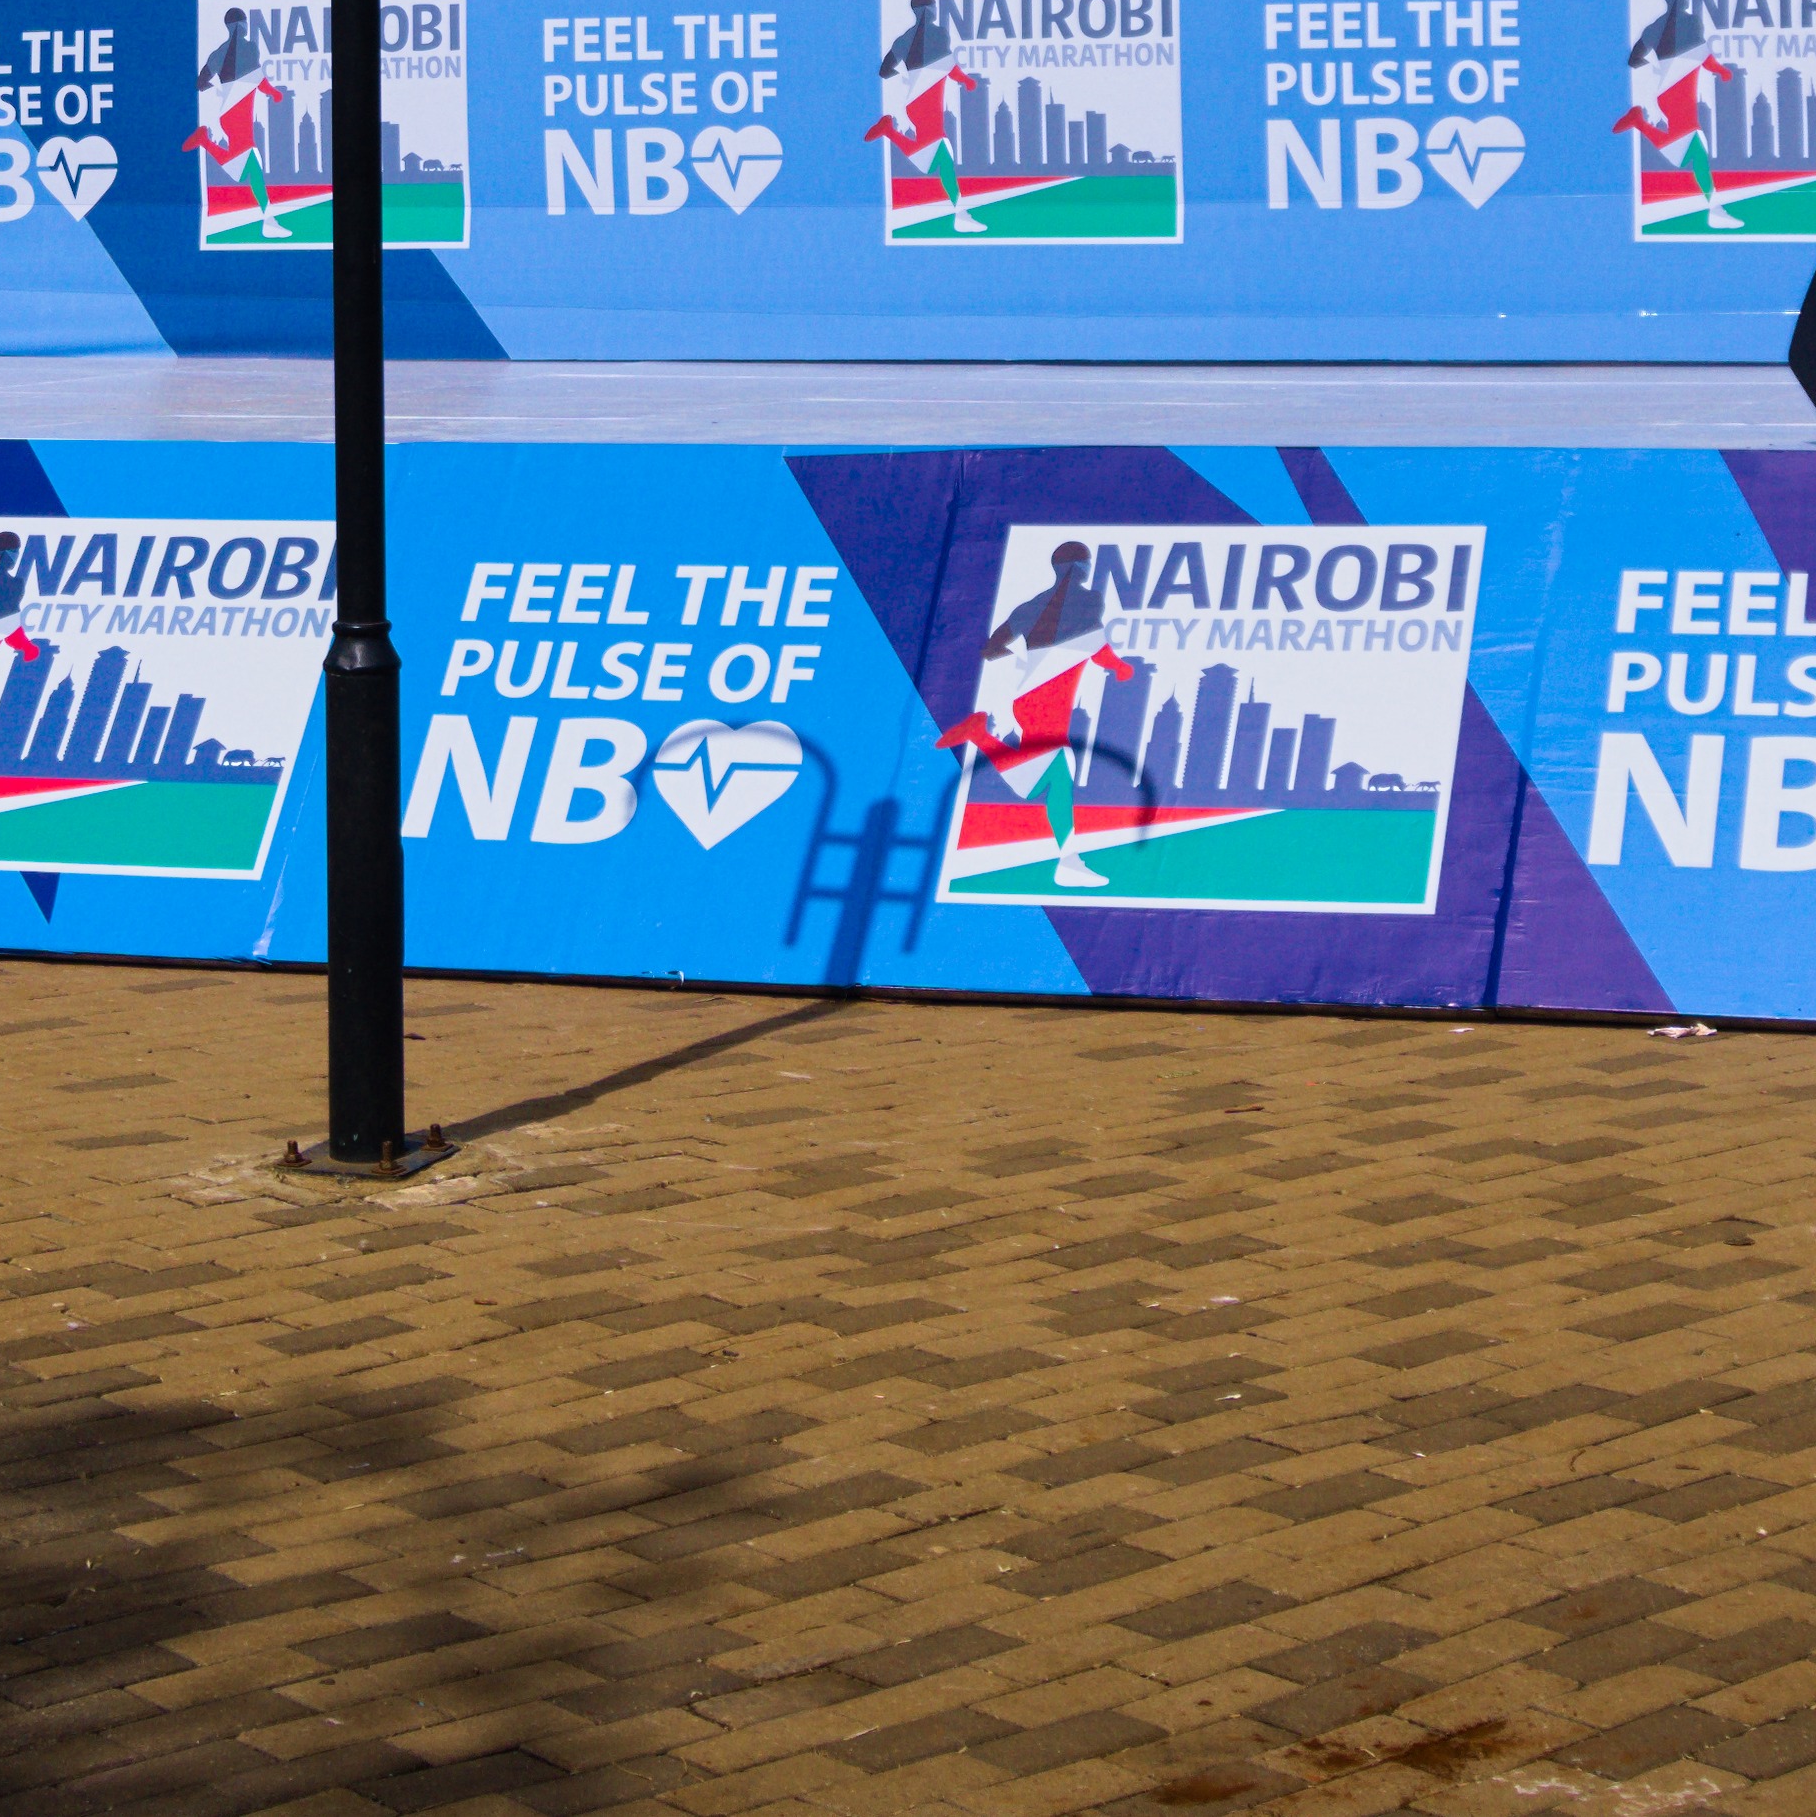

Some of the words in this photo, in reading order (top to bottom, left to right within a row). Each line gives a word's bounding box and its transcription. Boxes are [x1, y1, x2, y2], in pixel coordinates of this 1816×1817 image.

[249, 3, 460, 55] NAIOBI
[543, 17, 663, 62] FEEL
[674, 13, 778, 59] THE
[1264, 2, 1396, 50] FEEL
[1407, 0, 1519, 47] THE
[1708, 34, 1769, 59] CITY
[21, 29, 114, 73] THE
[262, 59, 313, 81] CITY
[953, 45, 1010, 68] CITY
[1018, 42, 1174, 67] MARATHON
[55, 84, 114, 125] OF
[545, 74, 697, 117] PULSE
[711, 71, 777, 114] OF
[1266, 61, 1433, 107] PULSE
[1448, 59, 1519, 104] OF
[14, 532, 337, 601] NAIROBI
[1091, 542, 1471, 612] NAIROBI
[460, 562, 659, 627] FEEL
[677, 565, 838, 629] THE
[19, 601, 105, 635] CITY
[105, 604, 331, 639] MARATHON
[1105, 618, 1199, 651] CITY
[1206, 618, 1464, 653] MARATHON
[440, 640, 687, 701] PULSE
[707, 643, 820, 704] OF
